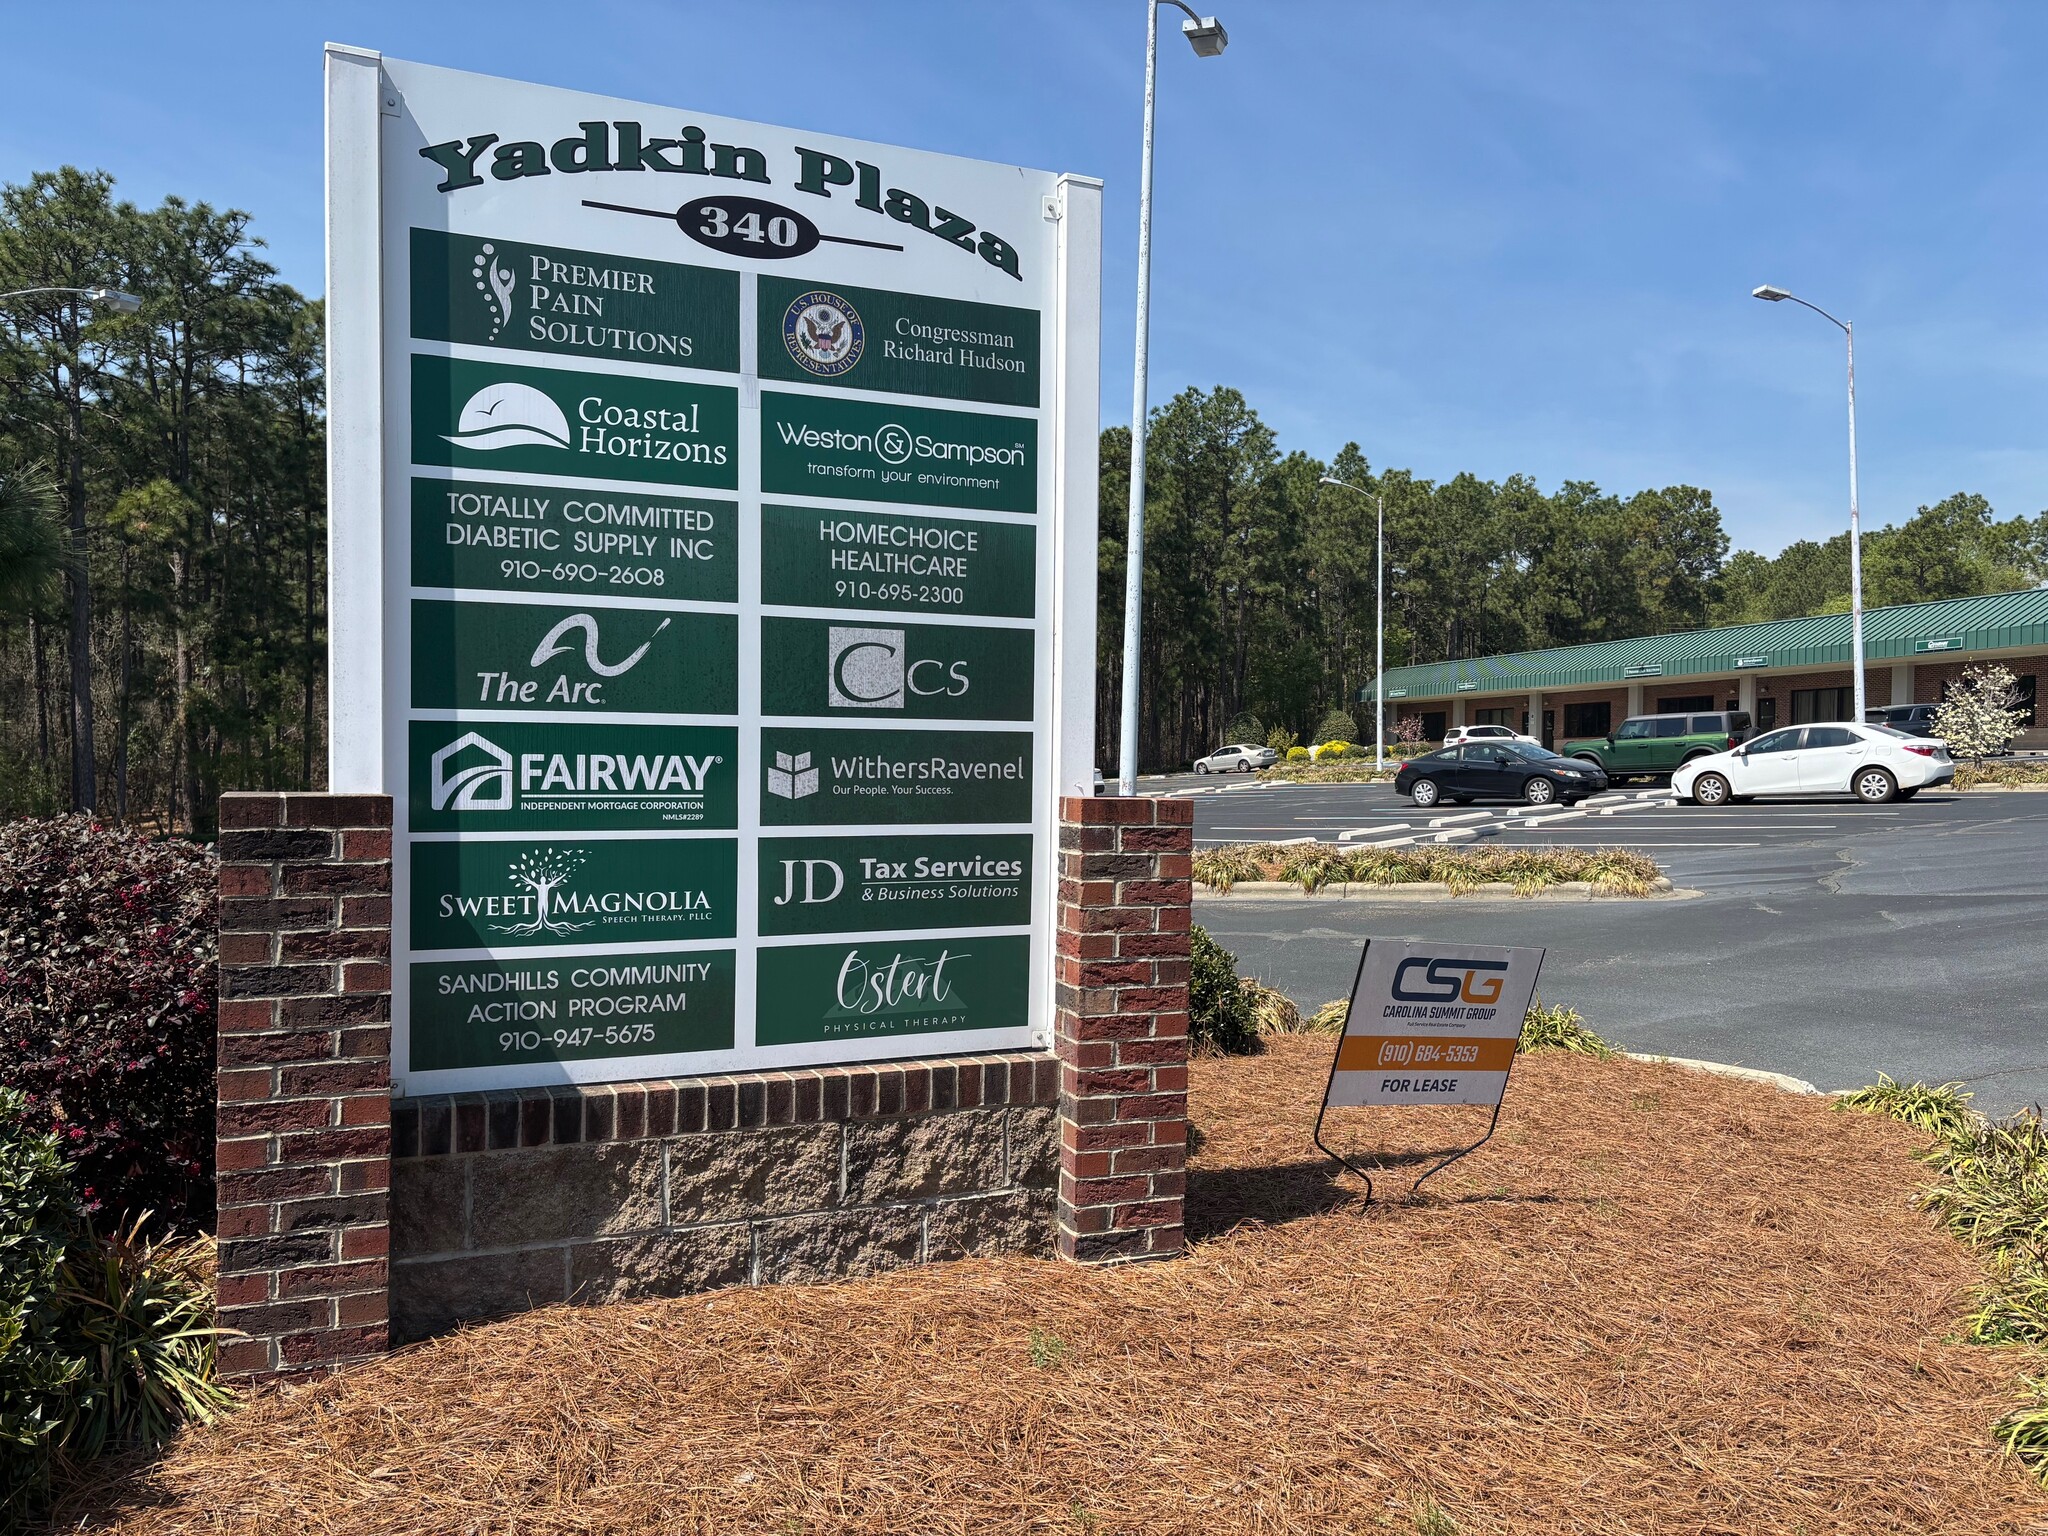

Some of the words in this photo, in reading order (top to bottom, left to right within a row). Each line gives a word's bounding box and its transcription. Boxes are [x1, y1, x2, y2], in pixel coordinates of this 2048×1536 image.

[419, 121, 771, 193] Yadkin
[794, 145, 1023, 282] Plaza
[699, 206, 798, 248] 340
[530, 255, 656, 294] PREMIER
[530, 284, 603, 317] PAIN
[791, 299, 810, 316] U.S.
[810, 294, 847, 313] HOUSE
[846, 311, 860, 325] OF
[530, 316, 692, 356] SOLUTIONS
[895, 317, 1014, 348] Congressman
[786, 332, 862, 373] REPRESENTATIVES
[883, 340, 954, 365] Richard
[959, 349, 1026, 373] Hudson
[578, 396, 700, 433] Coastal
[579, 426, 727, 465] Horizons
[777, 421, 872, 452] Weston
[915, 435, 1025, 466] Sampson
[807, 462, 876, 479] transform
[881, 470, 912, 483] your
[918, 472, 1000, 489] environment
[447, 493, 550, 520] TOTALLY
[563, 500, 714, 532] COMMITTED
[446, 523, 560, 551] DIABETIC
[573, 530, 658, 557] SUPPLY
[670, 537, 714, 561] INC
[820, 520, 978, 552] HOMECHOICE
[500, 560, 665, 586] 910-690-2608
[831, 549, 967, 578] HEALTHCARE
[835, 580, 964, 604] 910-695-2300
[477, 671, 539, 703] The
[831, 755, 1024, 780] WithersRavenel
[521, 802, 586, 810] INDEPENDENT
[588, 802, 638, 810] MORTGAGE
[640, 802, 704, 810] CORPORATION
[833, 785, 851, 795] Our
[853, 785, 889, 796] People.
[891, 785, 913, 795] Your
[915, 785, 954, 795] Success.
[774, 859, 844, 906] JD
[860, 858, 907, 879] Tax
[914, 855, 1022, 878] Services
[862, 887, 873, 901] &
[878, 887, 944, 901] Business
[948, 884, 1019, 899] Solutions
[439, 894, 536, 918] SWEET
[551, 890, 712, 915] MAGNOLIA
[602, 915, 637, 923] SPEECH
[689, 912, 712, 920] PLLC
[438, 970, 559, 995] SANDHILLS
[570, 962, 712, 988] COMMUNITY
[836, 950, 972, 1014] Ostert
[1391, 957, 1509, 1004] CSG
[466, 1000, 557, 1024] ACTION
[568, 993, 686, 1018] PROGRAM
[824, 1021, 894, 1033] PHYSICAL
[904, 1015, 966, 1027] THERAPY
[1383, 1005, 1428, 1018] CAROLINA
[1429, 1006, 1466, 1019] SUMMIT
[1466, 1008, 1497, 1020] GROUP
[499, 1024, 656, 1051] 910-947-5675
[1377, 1041, 1414, 1066] (910)
[1415, 1045, 1479, 1063] 684-5353
[1381, 1079, 1410, 1092] FOR
[1413, 1079, 1458, 1092] LEASE
